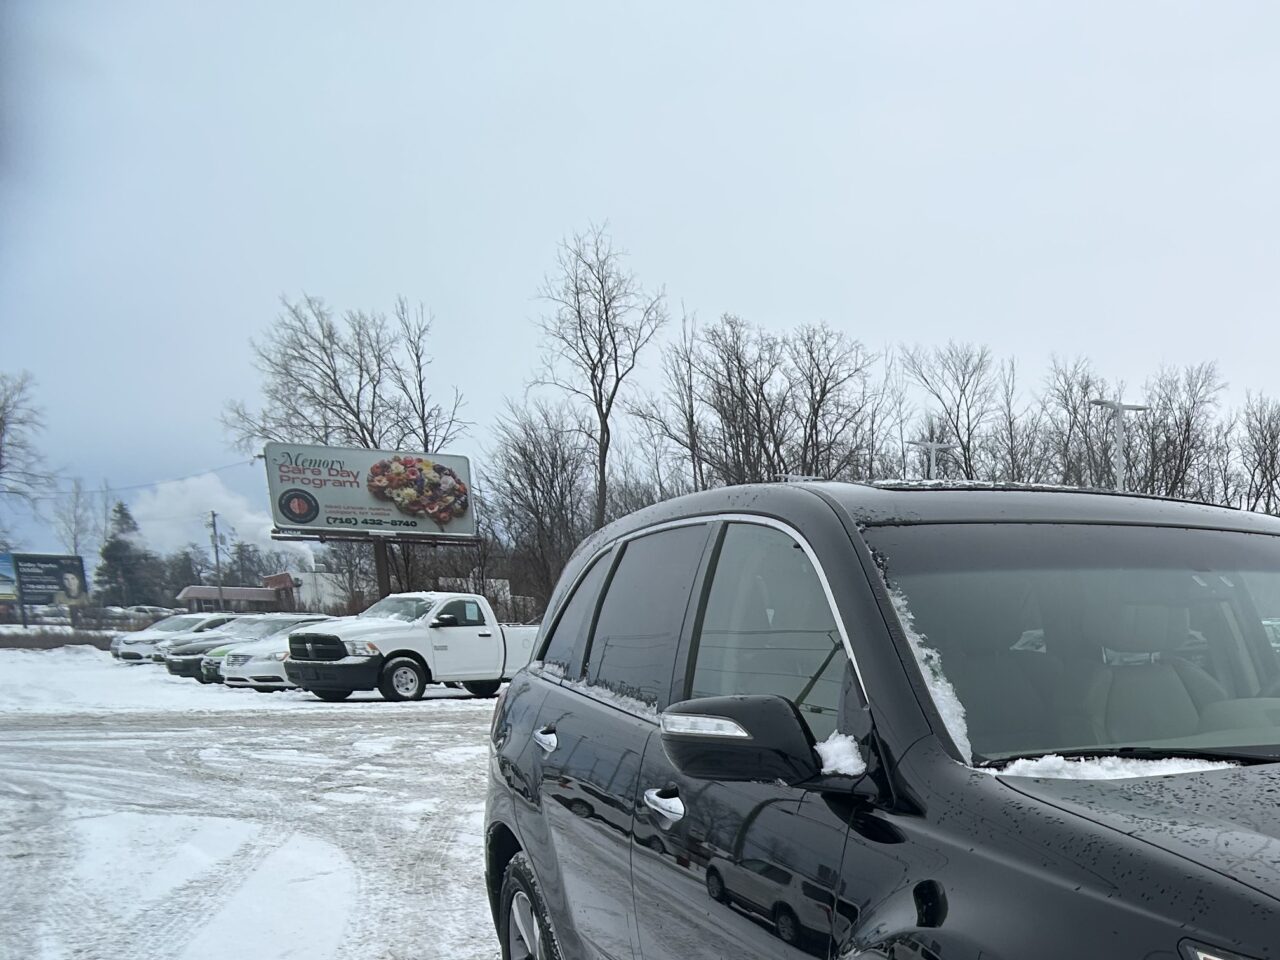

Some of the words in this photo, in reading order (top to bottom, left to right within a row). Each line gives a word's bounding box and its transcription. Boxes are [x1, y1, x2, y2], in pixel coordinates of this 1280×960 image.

[272, 452, 345, 470] Memory
[279, 464, 322, 476] Care
[328, 468, 360, 481] Day
[279, 475, 360, 489] Program
